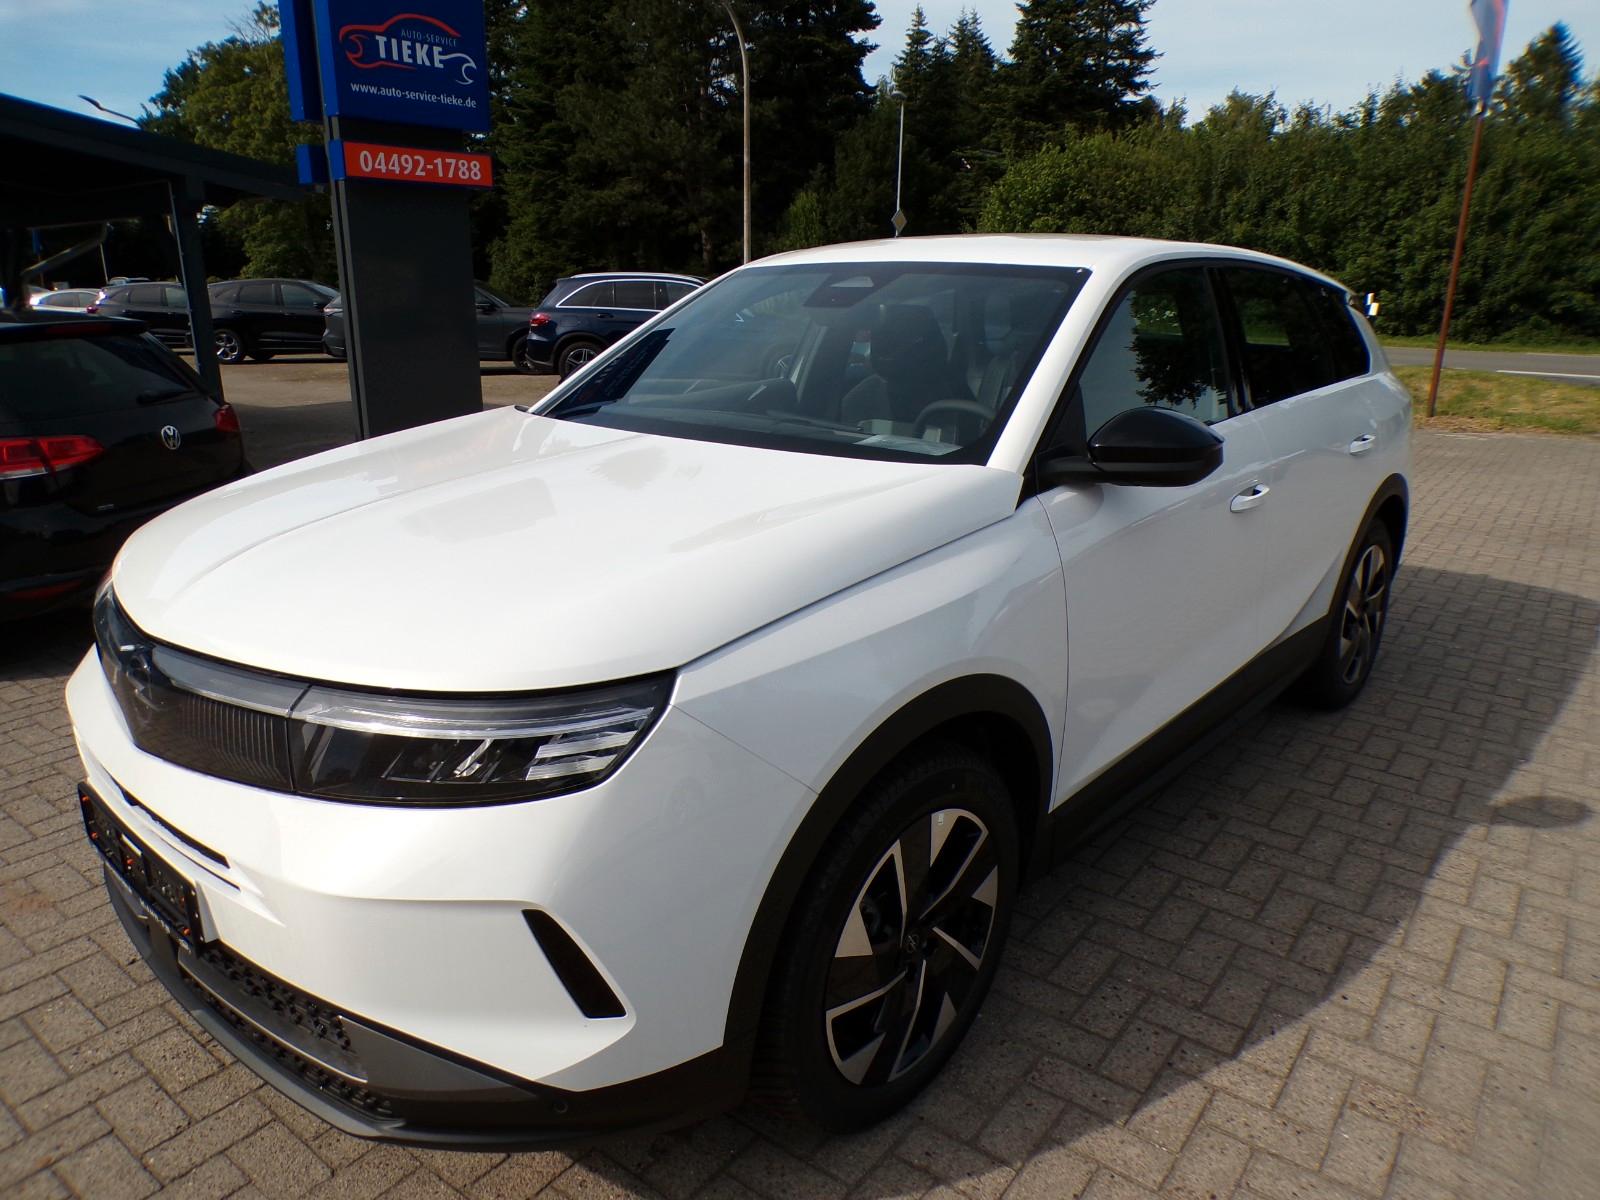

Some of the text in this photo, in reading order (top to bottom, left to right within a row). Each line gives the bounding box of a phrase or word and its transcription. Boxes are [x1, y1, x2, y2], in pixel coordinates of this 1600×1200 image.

[375, 35, 445, 69] TIEKE
[401, 29, 457, 48] AUTO-SERVICE
[350, 82, 477, 109] www.auto-service-tieke.de
[359, 150, 481, 181] 04492-1788
